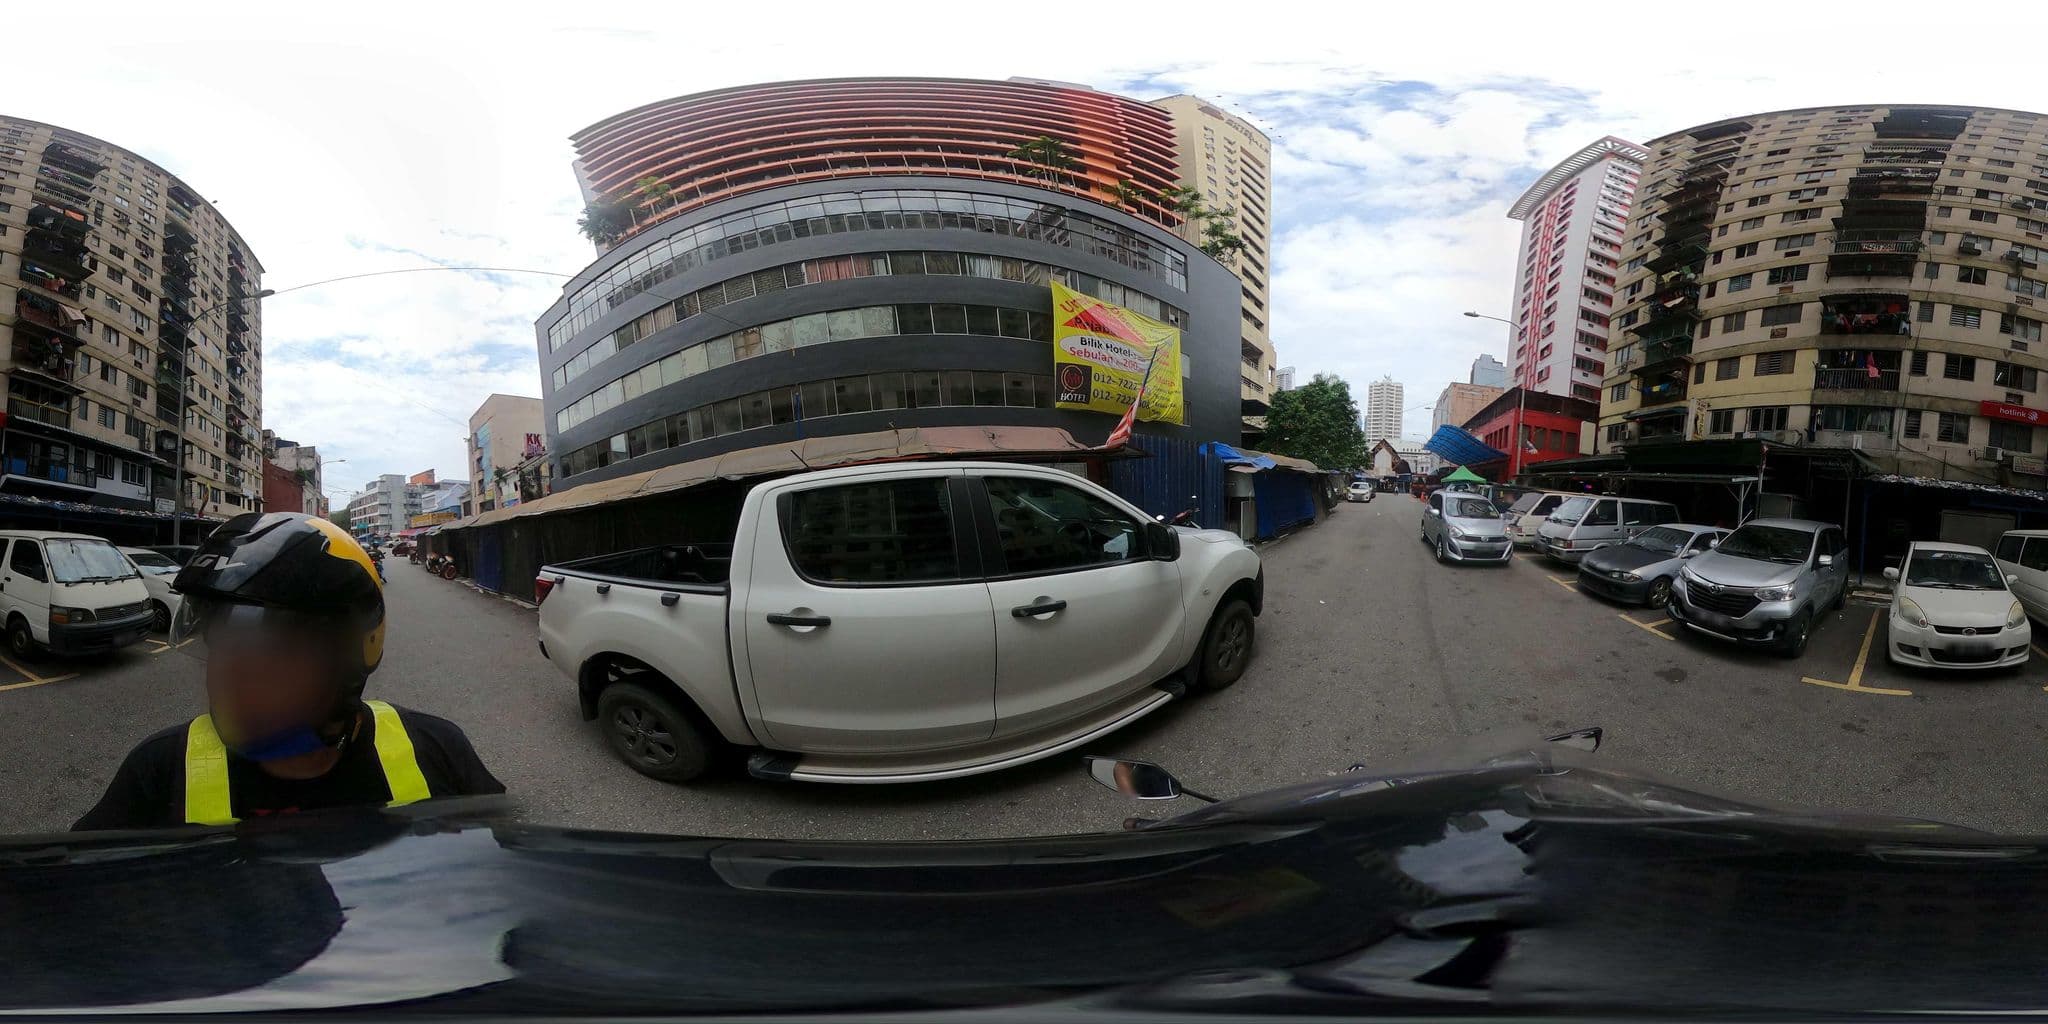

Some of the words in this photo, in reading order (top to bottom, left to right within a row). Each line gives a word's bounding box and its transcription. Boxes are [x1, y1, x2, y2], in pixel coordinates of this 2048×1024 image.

[1080, 336, 1104, 349] Bilik
[1069, 346, 1114, 363] Sebulan
[1060, 392, 1087, 402] HOTEL
[1999, 407, 2026, 417] hotlink
